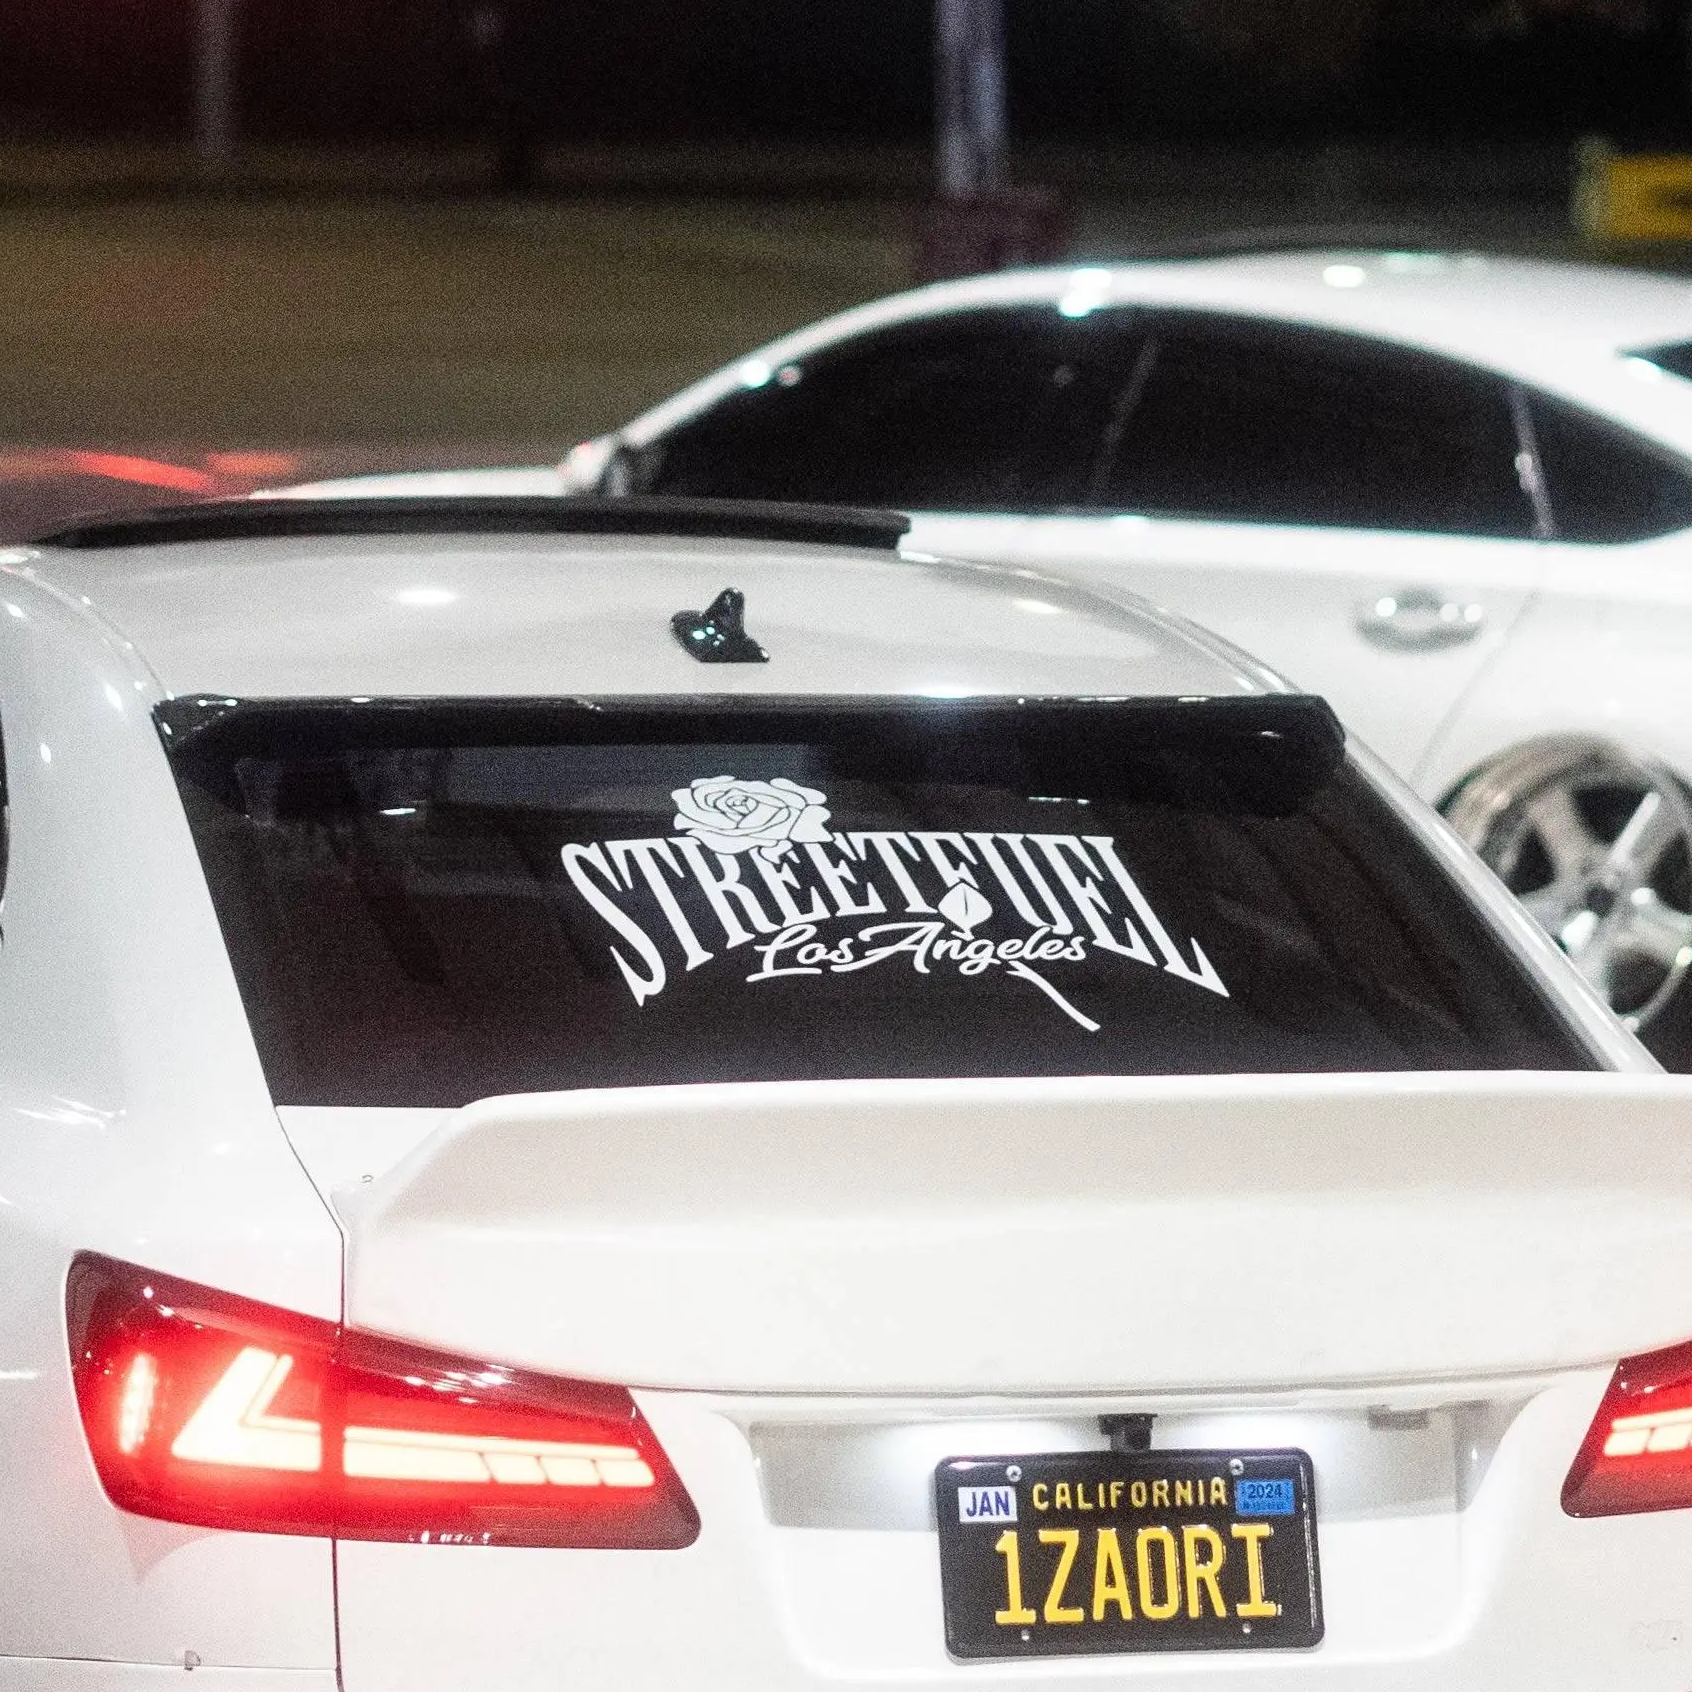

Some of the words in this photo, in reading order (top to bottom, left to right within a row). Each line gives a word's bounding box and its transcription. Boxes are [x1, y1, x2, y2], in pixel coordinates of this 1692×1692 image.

[561, 831, 1230, 1006] STREETFUEL
[746, 923, 855, 983] Los
[830, 921, 1087, 975] Angeles
[965, 1491, 1010, 1517] JAN
[1032, 1476, 1229, 1511] CALIFORNIA
[1247, 1482, 1284, 1499] 2024
